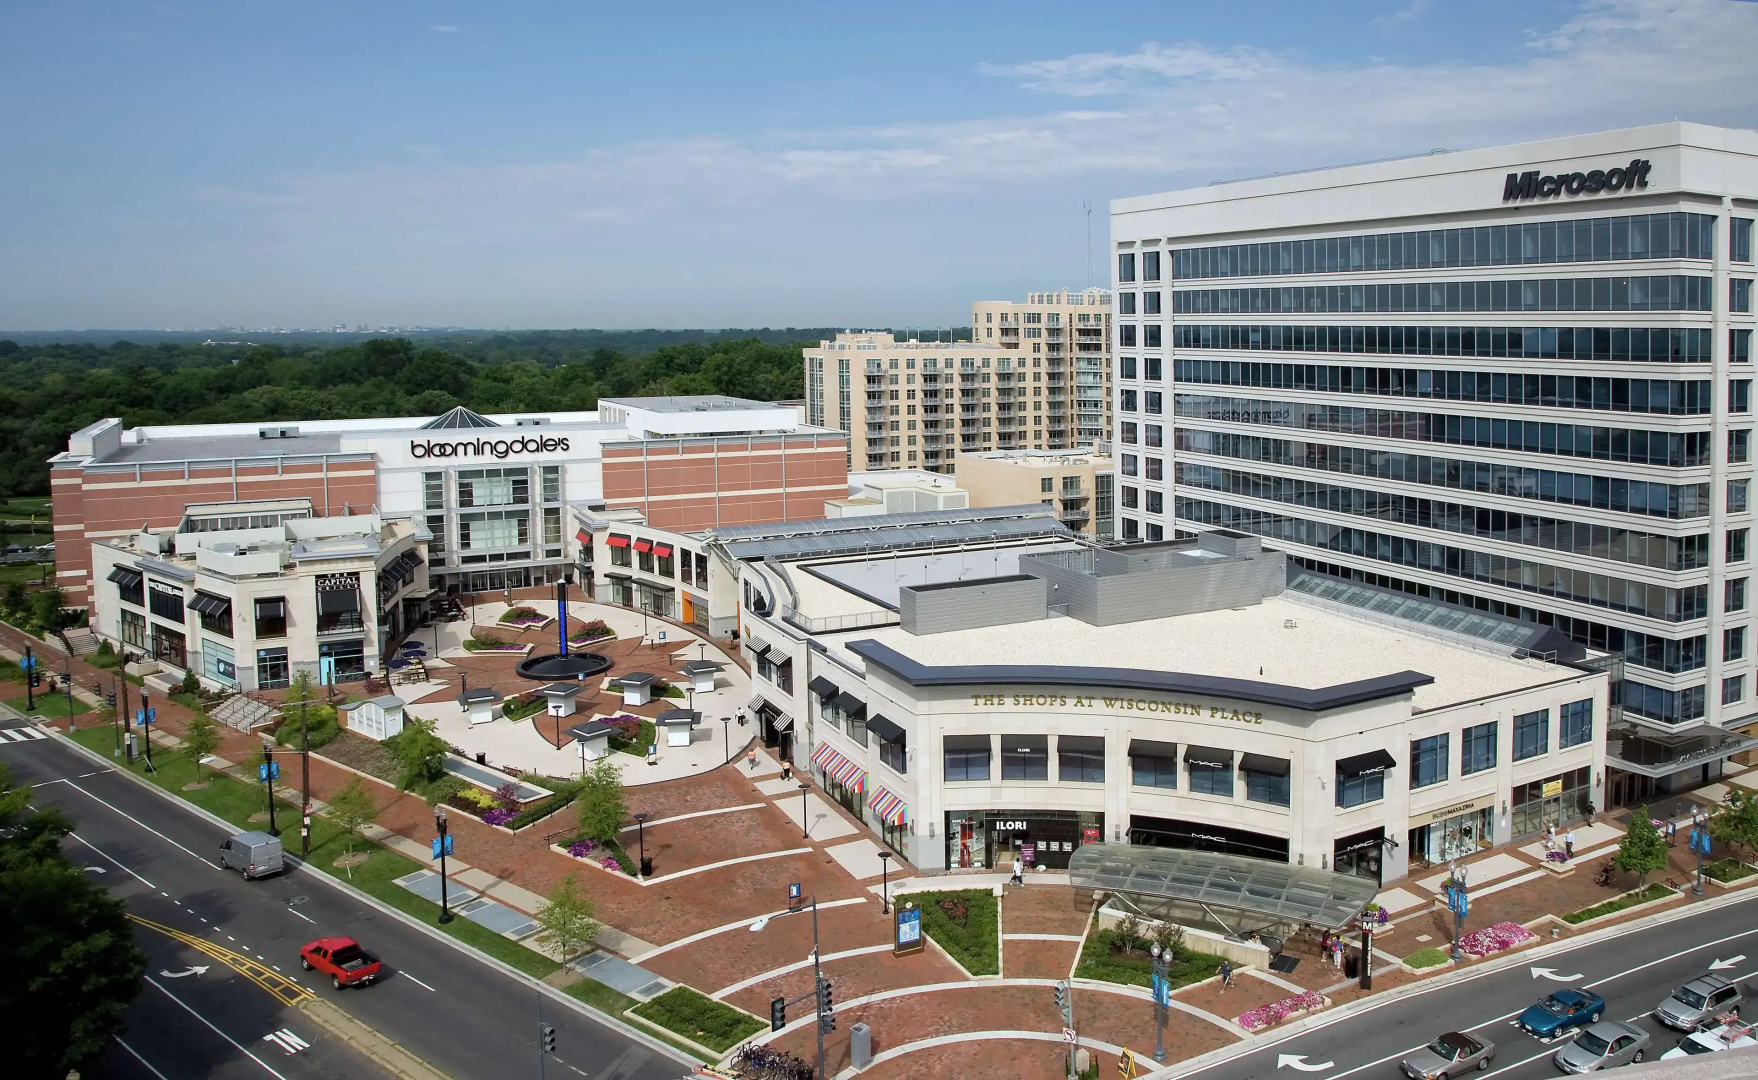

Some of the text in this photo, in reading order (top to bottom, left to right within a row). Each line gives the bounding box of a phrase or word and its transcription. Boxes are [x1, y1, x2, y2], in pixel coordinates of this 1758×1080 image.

[1503, 159, 1652, 200] Microsoft
[411, 435, 570, 458] bloomingdale's
[317, 577, 357, 586] CAPITAL
[971, 694, 1263, 725] THE SHOPS AT WISCONSIN PLACE
[1189, 759, 1223, 768] MAC
[1359, 765, 1385, 776] MAC
[996, 821, 1027, 830] ILORI
[1191, 832, 1226, 843] MAC
[1347, 839, 1374, 852] MAC
[1362, 921, 1372, 930] M
